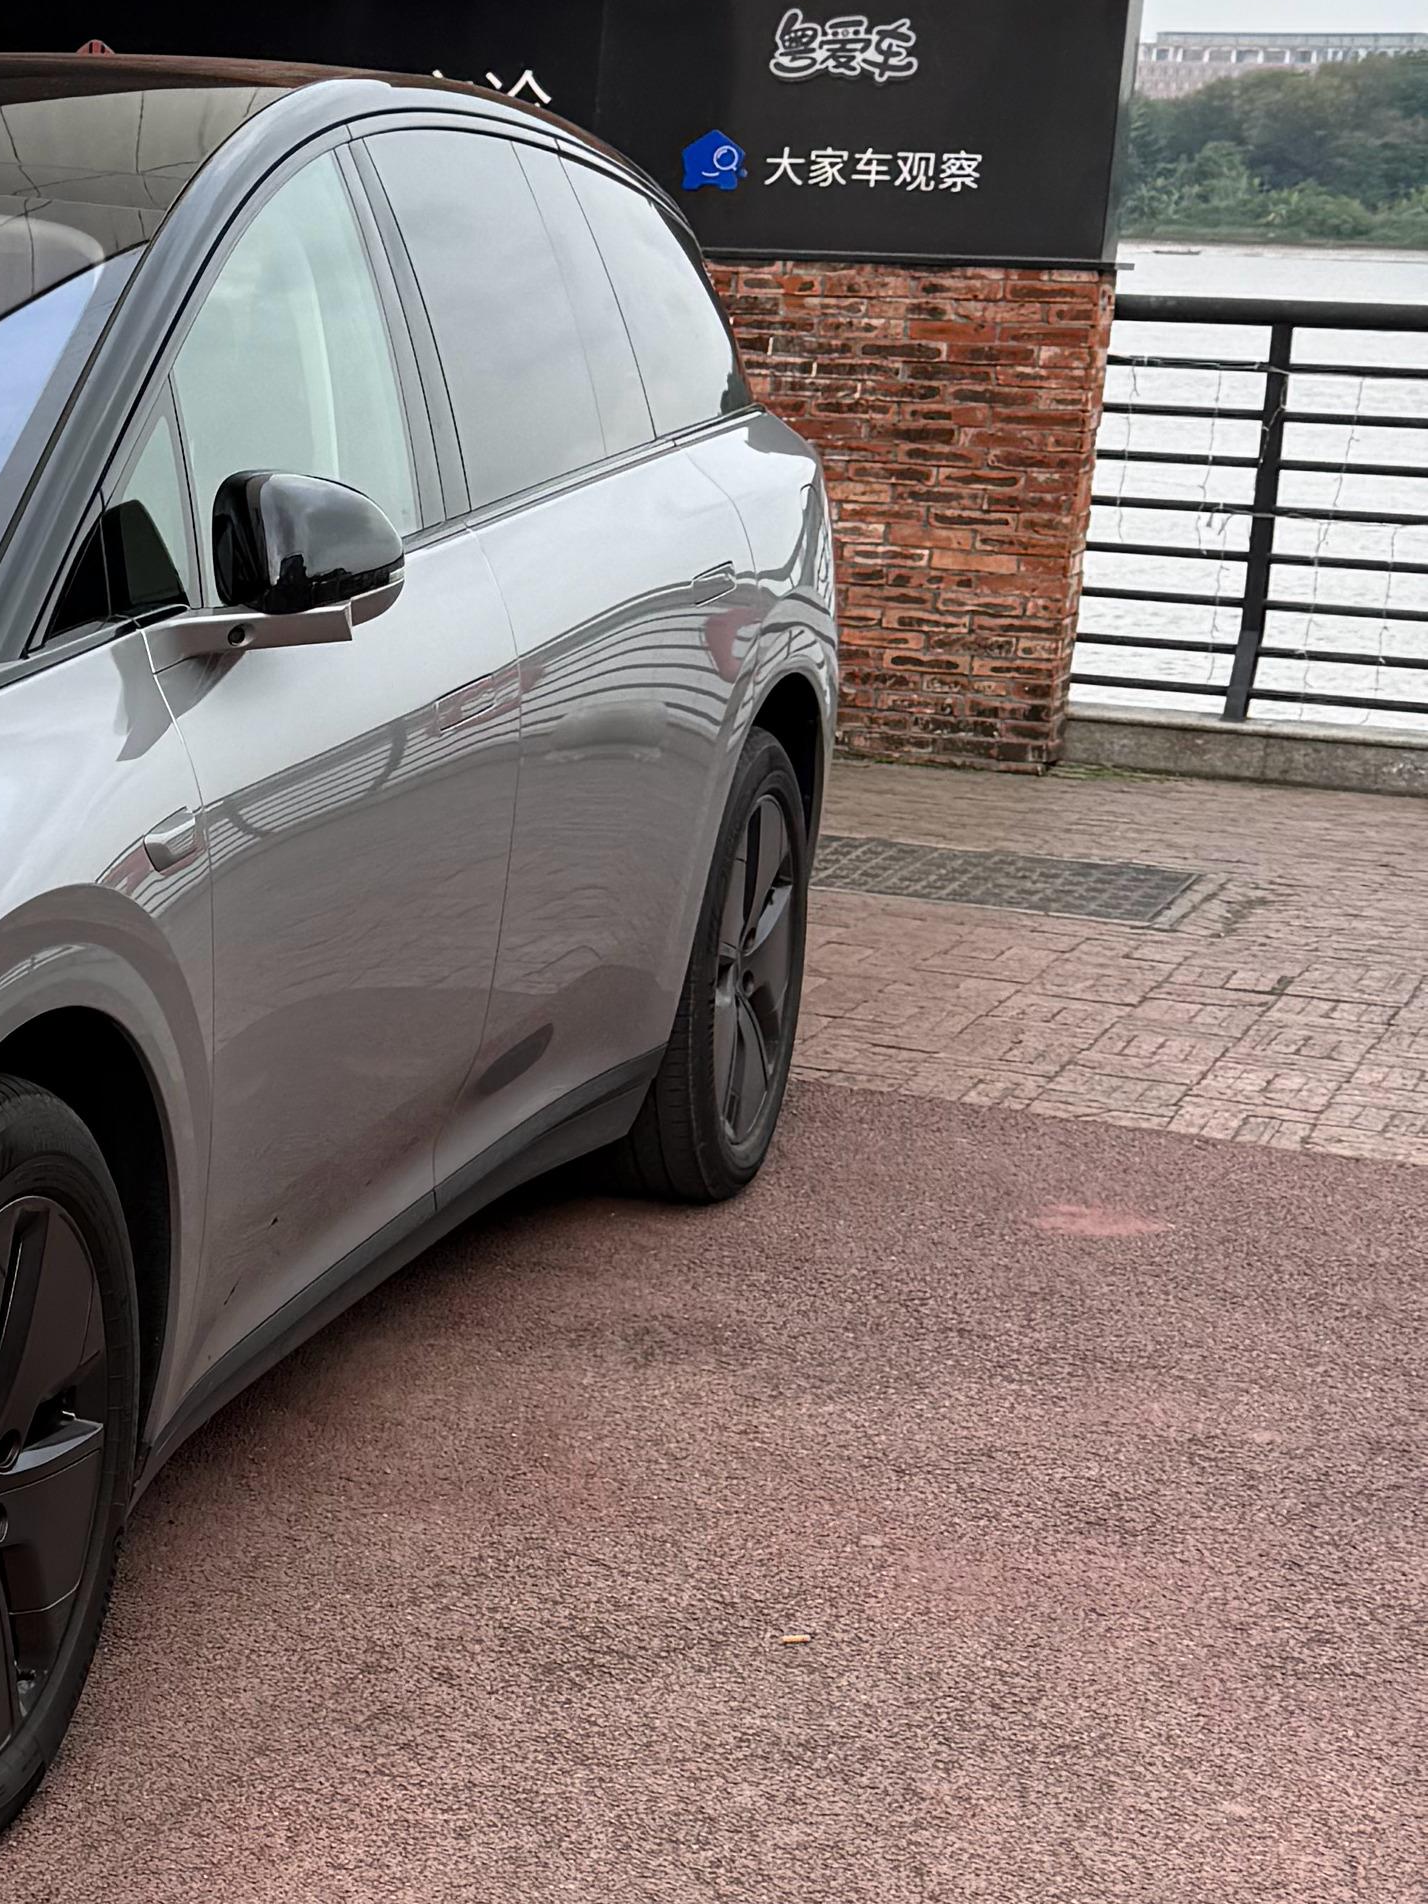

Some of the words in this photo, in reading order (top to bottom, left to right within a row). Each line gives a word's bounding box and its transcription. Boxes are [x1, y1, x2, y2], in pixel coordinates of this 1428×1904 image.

[764, 146, 983, 192] 大家车观察
